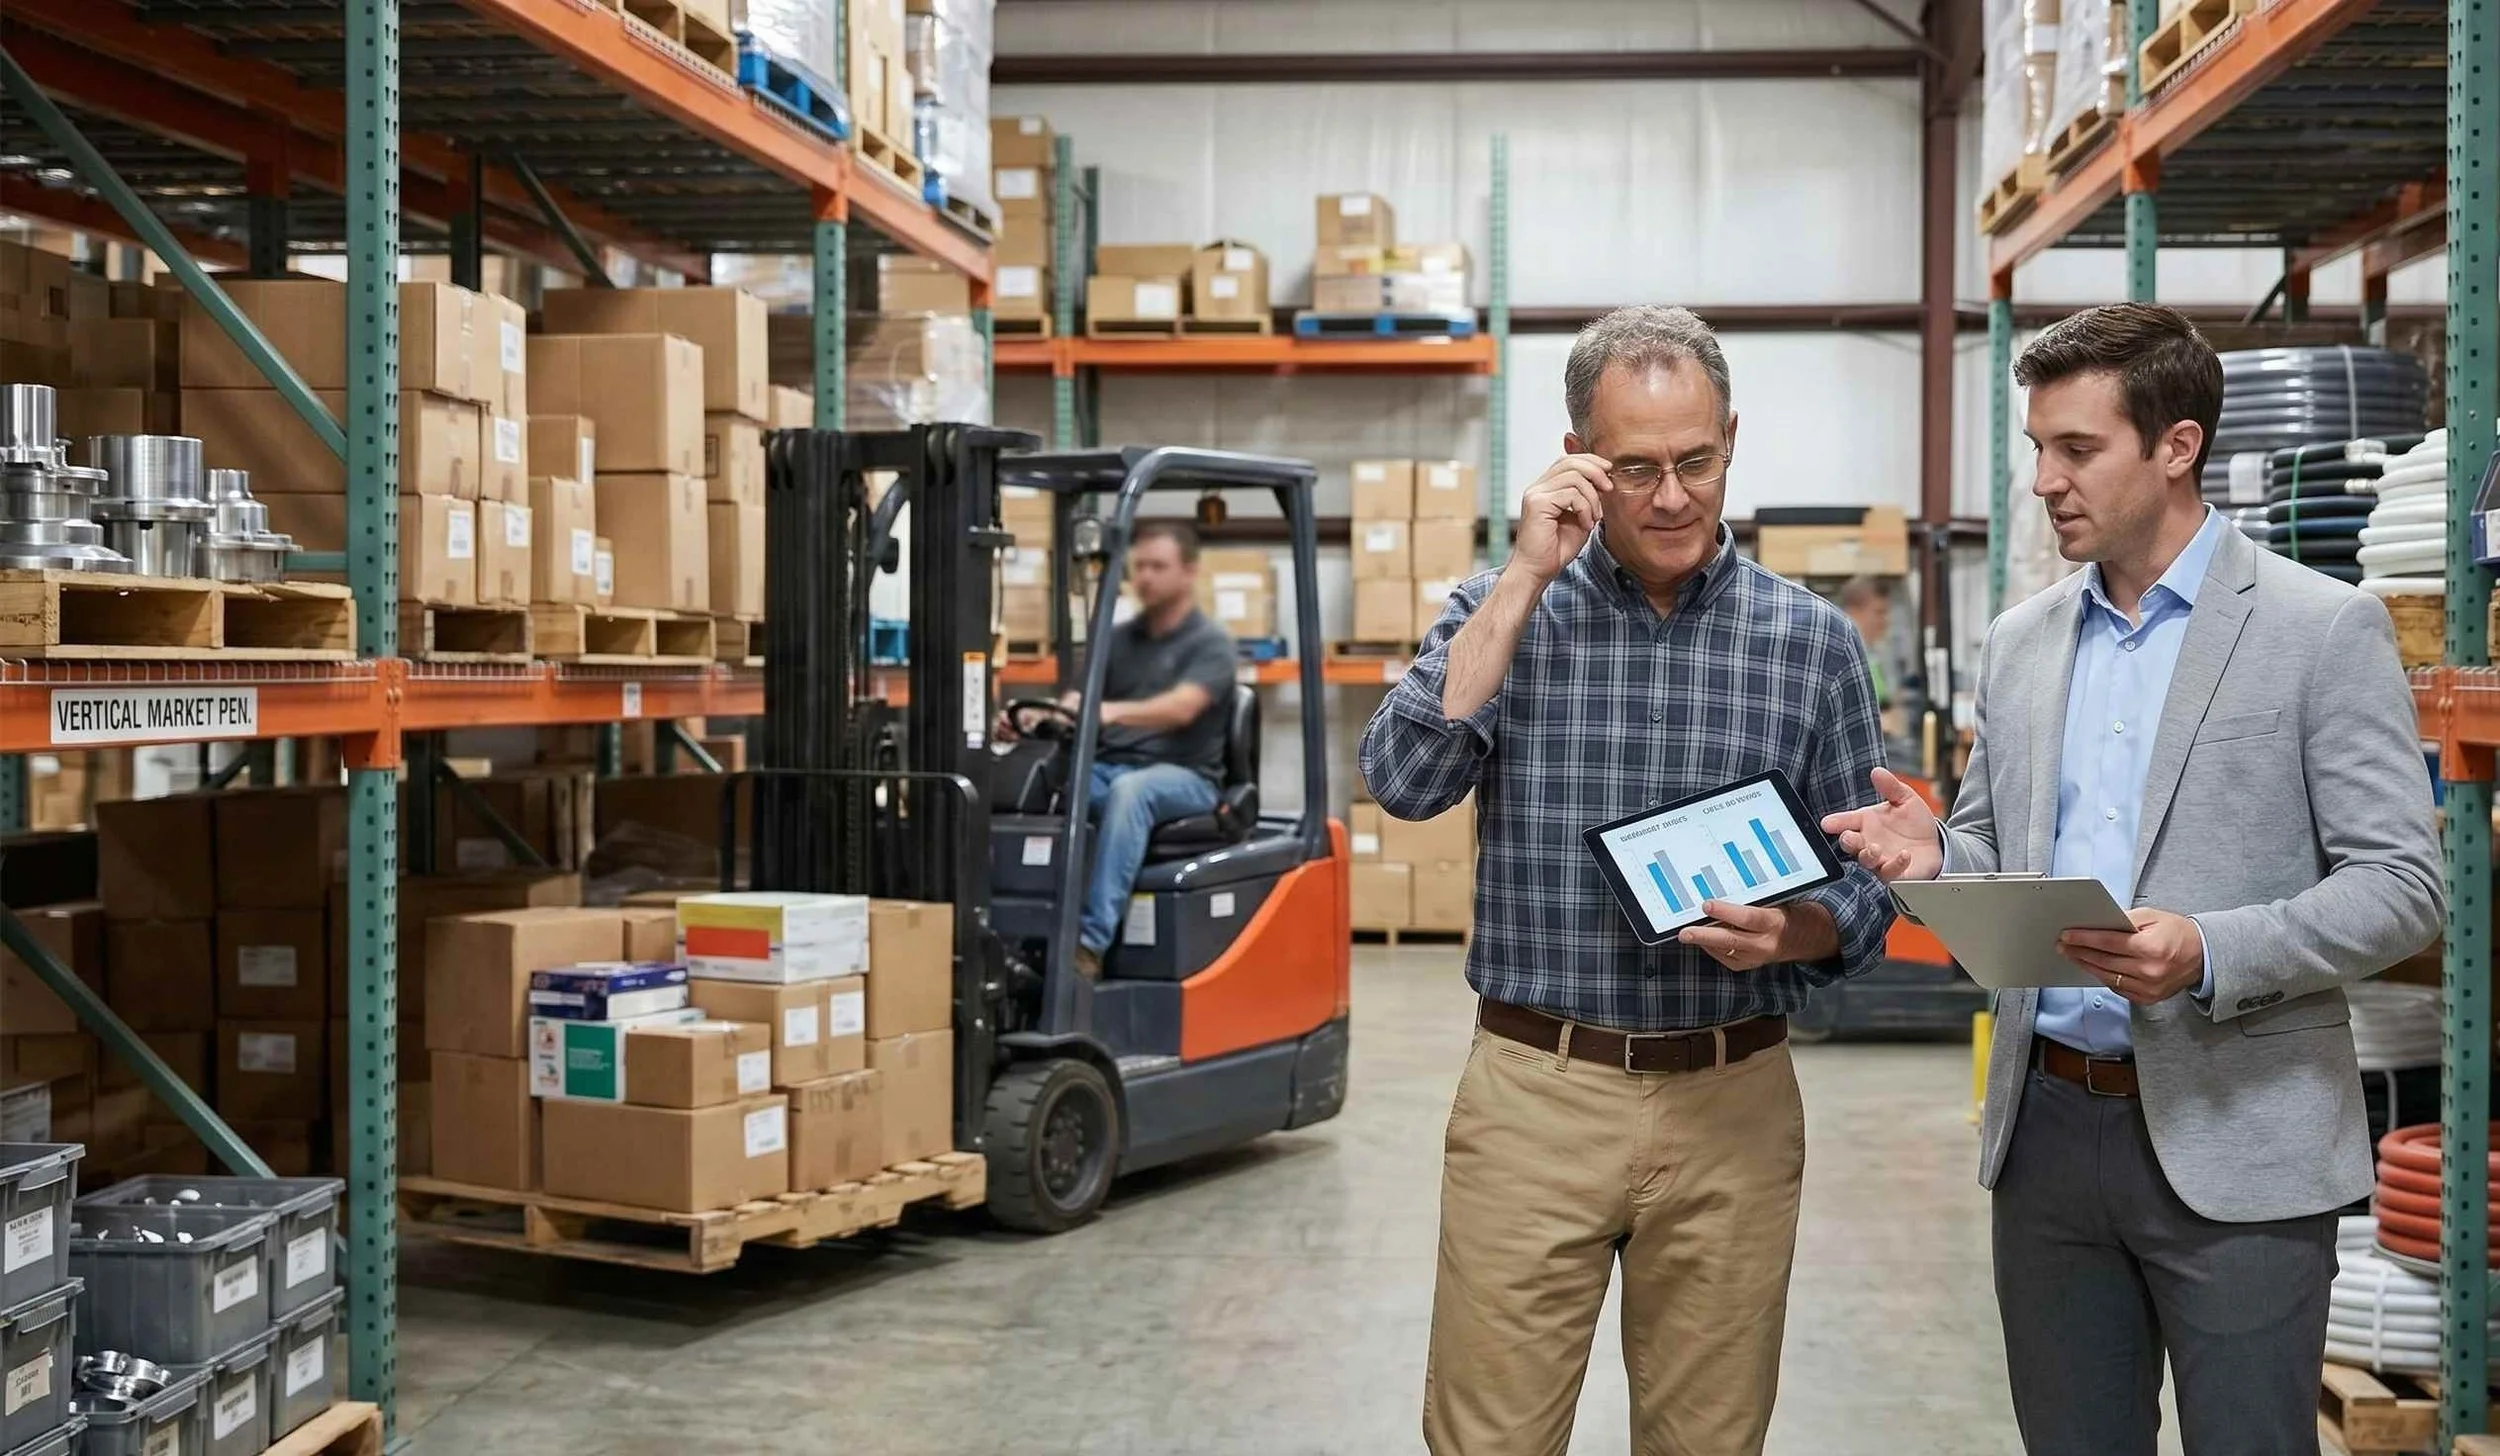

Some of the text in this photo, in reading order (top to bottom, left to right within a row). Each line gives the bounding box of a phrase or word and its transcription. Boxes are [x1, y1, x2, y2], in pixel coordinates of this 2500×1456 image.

[57, 696, 252, 731] VERTICAL MARKET PEN.
